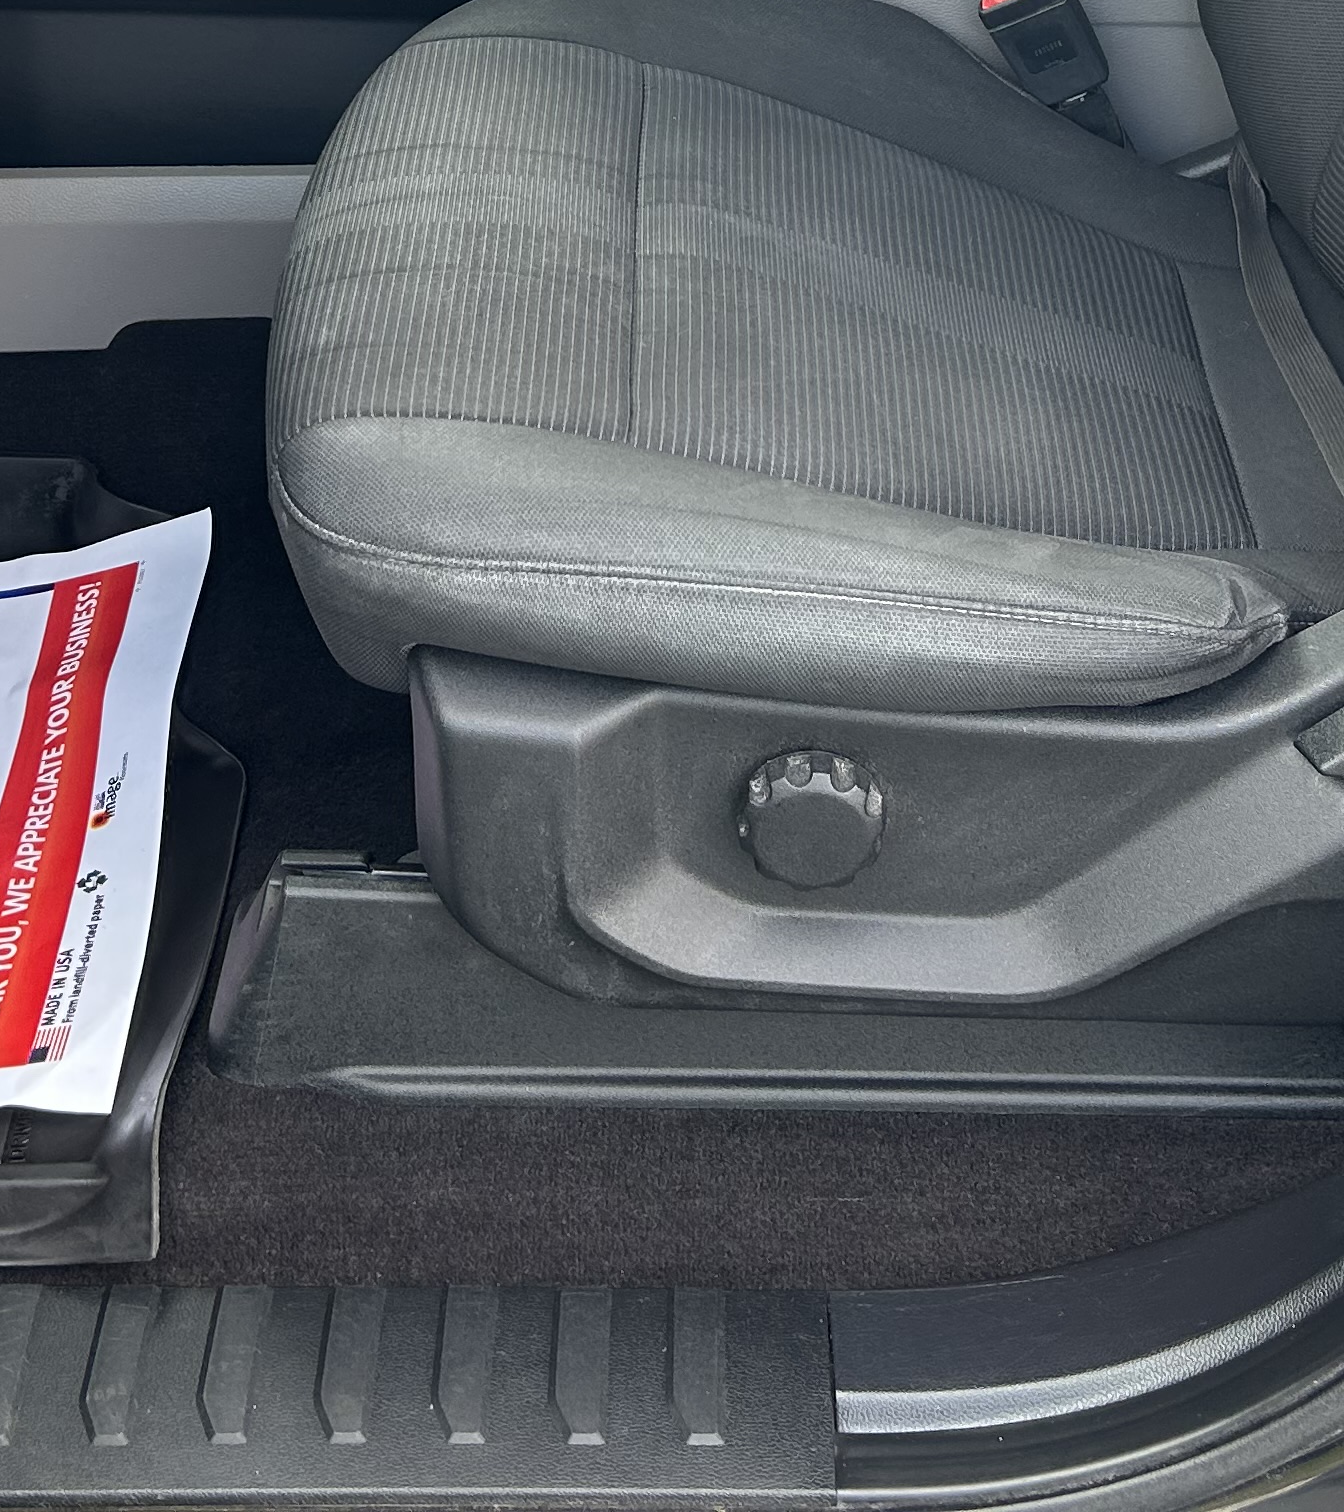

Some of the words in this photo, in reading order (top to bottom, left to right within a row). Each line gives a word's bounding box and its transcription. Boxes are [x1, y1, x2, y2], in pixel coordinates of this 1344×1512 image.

[57, 581, 103, 677] BUSINESS!
[44, 675, 76, 743] YOUR
[13, 743, 66, 873] APPRECIATE
[1, 877, 36, 918] WE
[52, 976, 68, 990] IN
[55, 948, 76, 974] USA
[62, 998, 80, 1024] From
[91, 893, 106, 922] paper
[41, 992, 64, 1026] MADE
